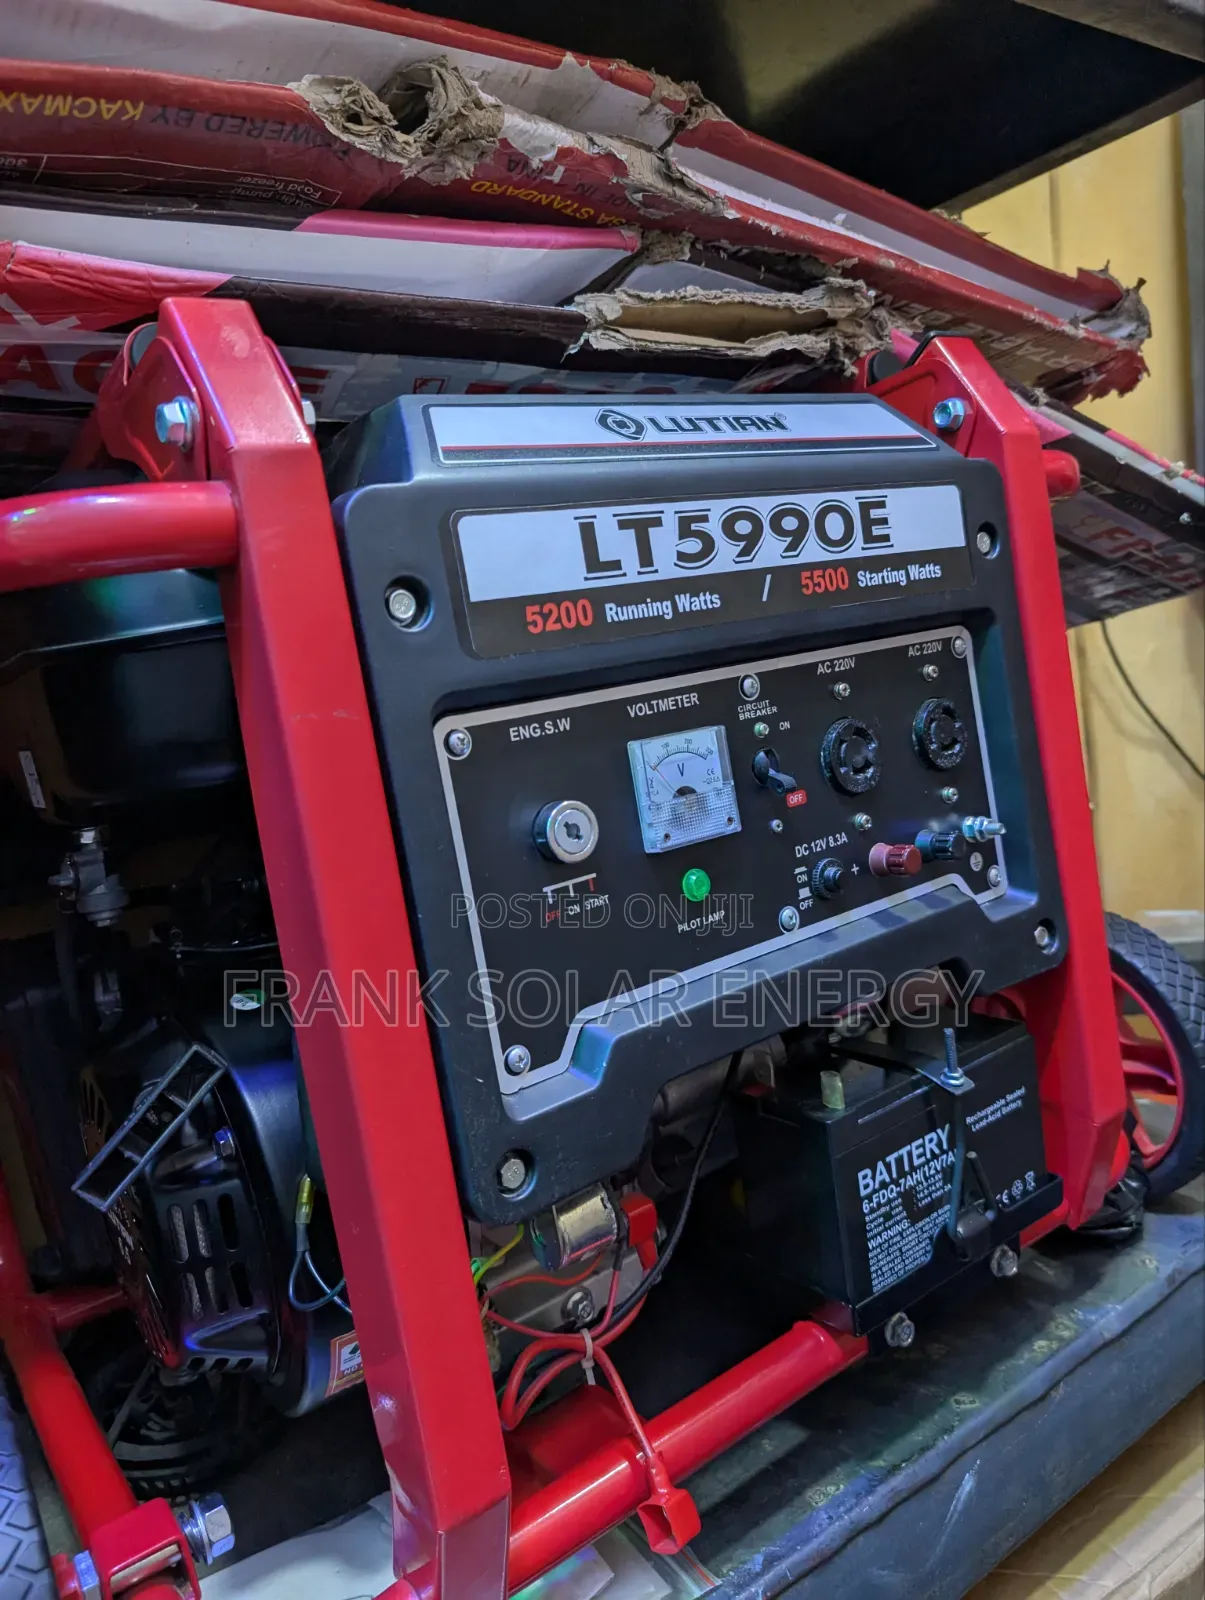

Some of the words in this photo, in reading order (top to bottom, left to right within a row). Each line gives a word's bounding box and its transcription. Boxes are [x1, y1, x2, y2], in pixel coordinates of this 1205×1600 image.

[0, 91, 145, 121] KACMAX
[151, 104, 196, 128] BY
[234, 175, 286, 191] freezer
[470, 180, 595, 220] STANDARD
[644, 413, 791, 434] LUTIAN
[573, 495, 894, 581] LT5990E
[525, 598, 594, 635] 5200
[604, 597, 674, 624] Running
[675, 591, 721, 612] Watts
[761, 574, 772, 602] /
[800, 566, 850, 596] 5500
[857, 569, 908, 589] Starting
[908, 562, 942, 581] Watts
[907, 645, 922, 658] AC
[922, 641, 943, 655] 220V
[816, 661, 832, 676] AC
[833, 656, 856, 673] 220V
[626, 692, 700, 718] VOLTMETER
[737, 699, 770, 714] CIRCUIT
[738, 705, 778, 722] BREAKER
[508, 717, 571, 742] ENG.S.W
[779, 721, 791, 732] ON
[676, 762, 685, 778] V
[788, 793, 803, 805] OFF
[794, 843, 810, 859] DC
[810, 838, 828, 854] 12V
[828, 831, 848, 848] 8.3A
[796, 873, 808, 884] ON
[567, 903, 580, 916] ON
[584, 895, 610, 911] START
[799, 898, 814, 911] OFF
[545, 910, 561, 923] OFF
[677, 918, 702, 934] PILOT
[702, 910, 725, 926] LAMP
[965, 1098, 1006, 1125] Rechargeable
[1006, 1085, 1026, 1102] Sealed
[971, 1111, 1002, 1132] Lead-Acid
[1001, 1099, 1023, 1116] Battery
[857, 1123, 951, 1197] BATTERY
[862, 1148, 957, 1214] 6-FDQ-7AH(12V7A
[864, 1204, 890, 1222] Standby
[890, 1197, 902, 1208] use
[866, 1217, 884, 1230] Cycle
[891, 1205, 903, 1216] use
[867, 1224, 884, 1239] Initial
[884, 1210, 907, 1228] current
[867, 1219, 911, 1250] WARNING:
[869, 1256, 878, 1266] DO
[877, 1250, 888, 1261] NOT
